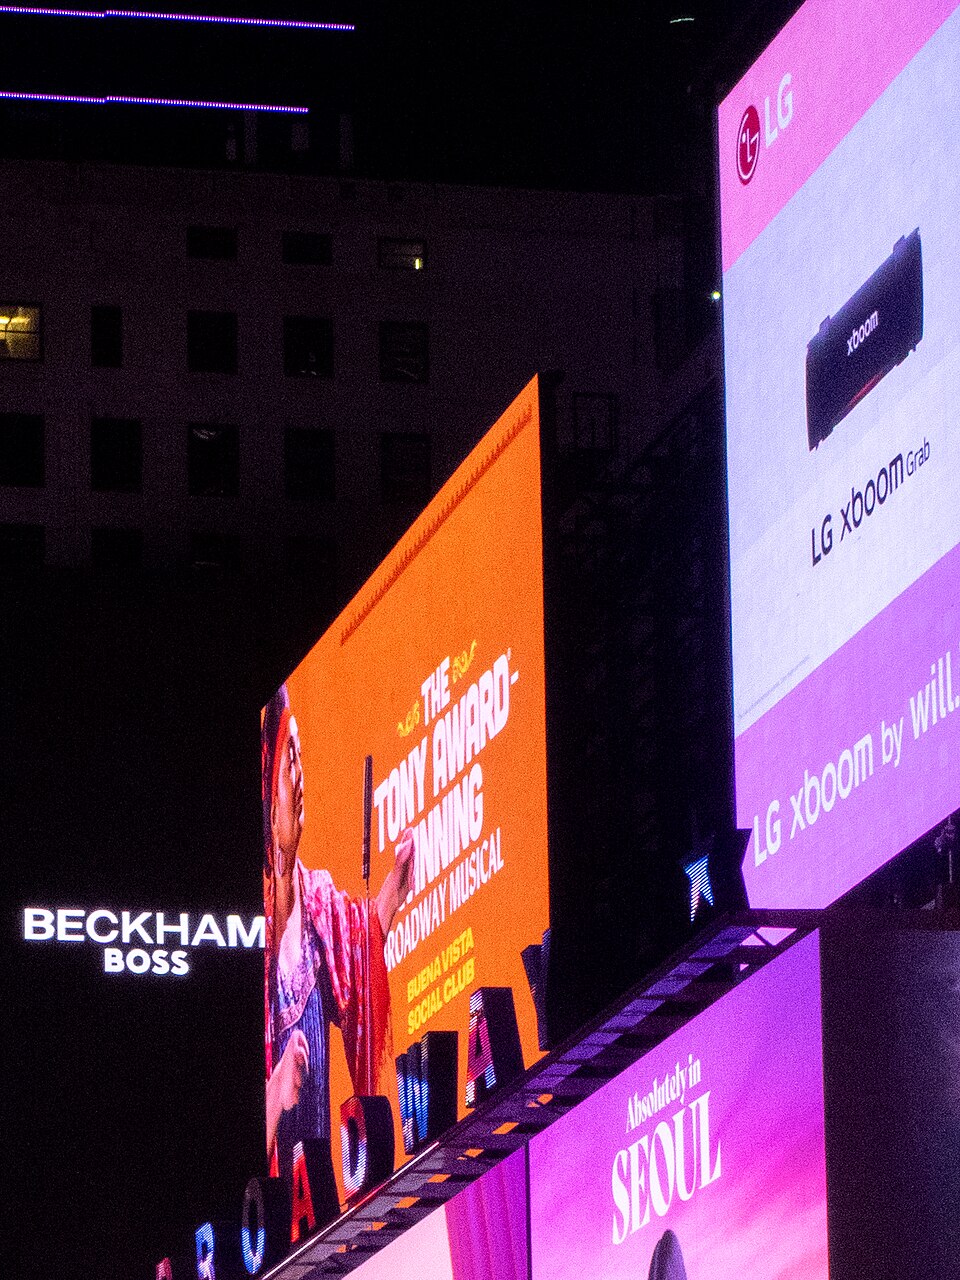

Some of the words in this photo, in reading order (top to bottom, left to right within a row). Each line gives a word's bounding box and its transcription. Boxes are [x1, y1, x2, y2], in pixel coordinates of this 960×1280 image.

[764, 72, 794, 149] LG
[847, 309, 879, 357] xboom
[811, 513, 833, 567] LG
[840, 453, 904, 542] xboom
[906, 436, 930, 476] Grab
[421, 656, 451, 724] THE
[374, 736, 428, 854] TONY
[753, 799, 782, 868] LG
[790, 733, 874, 840] xboom
[881, 716, 904, 768] by
[449, 827, 504, 916] MUSICAL
[24, 907, 266, 949] BECKHAM
[104, 947, 190, 976] BOSS
[407, 956, 441, 1003] BUENA
[442, 927, 474, 973] VISTA
[408, 986, 443, 1035] SOCIAL
[443, 957, 475, 1004] CLUB
[626, 1061, 685, 1133] Absolutely
[687, 1053, 701, 1089] in
[611, 1090, 722, 1245] SEOUL
